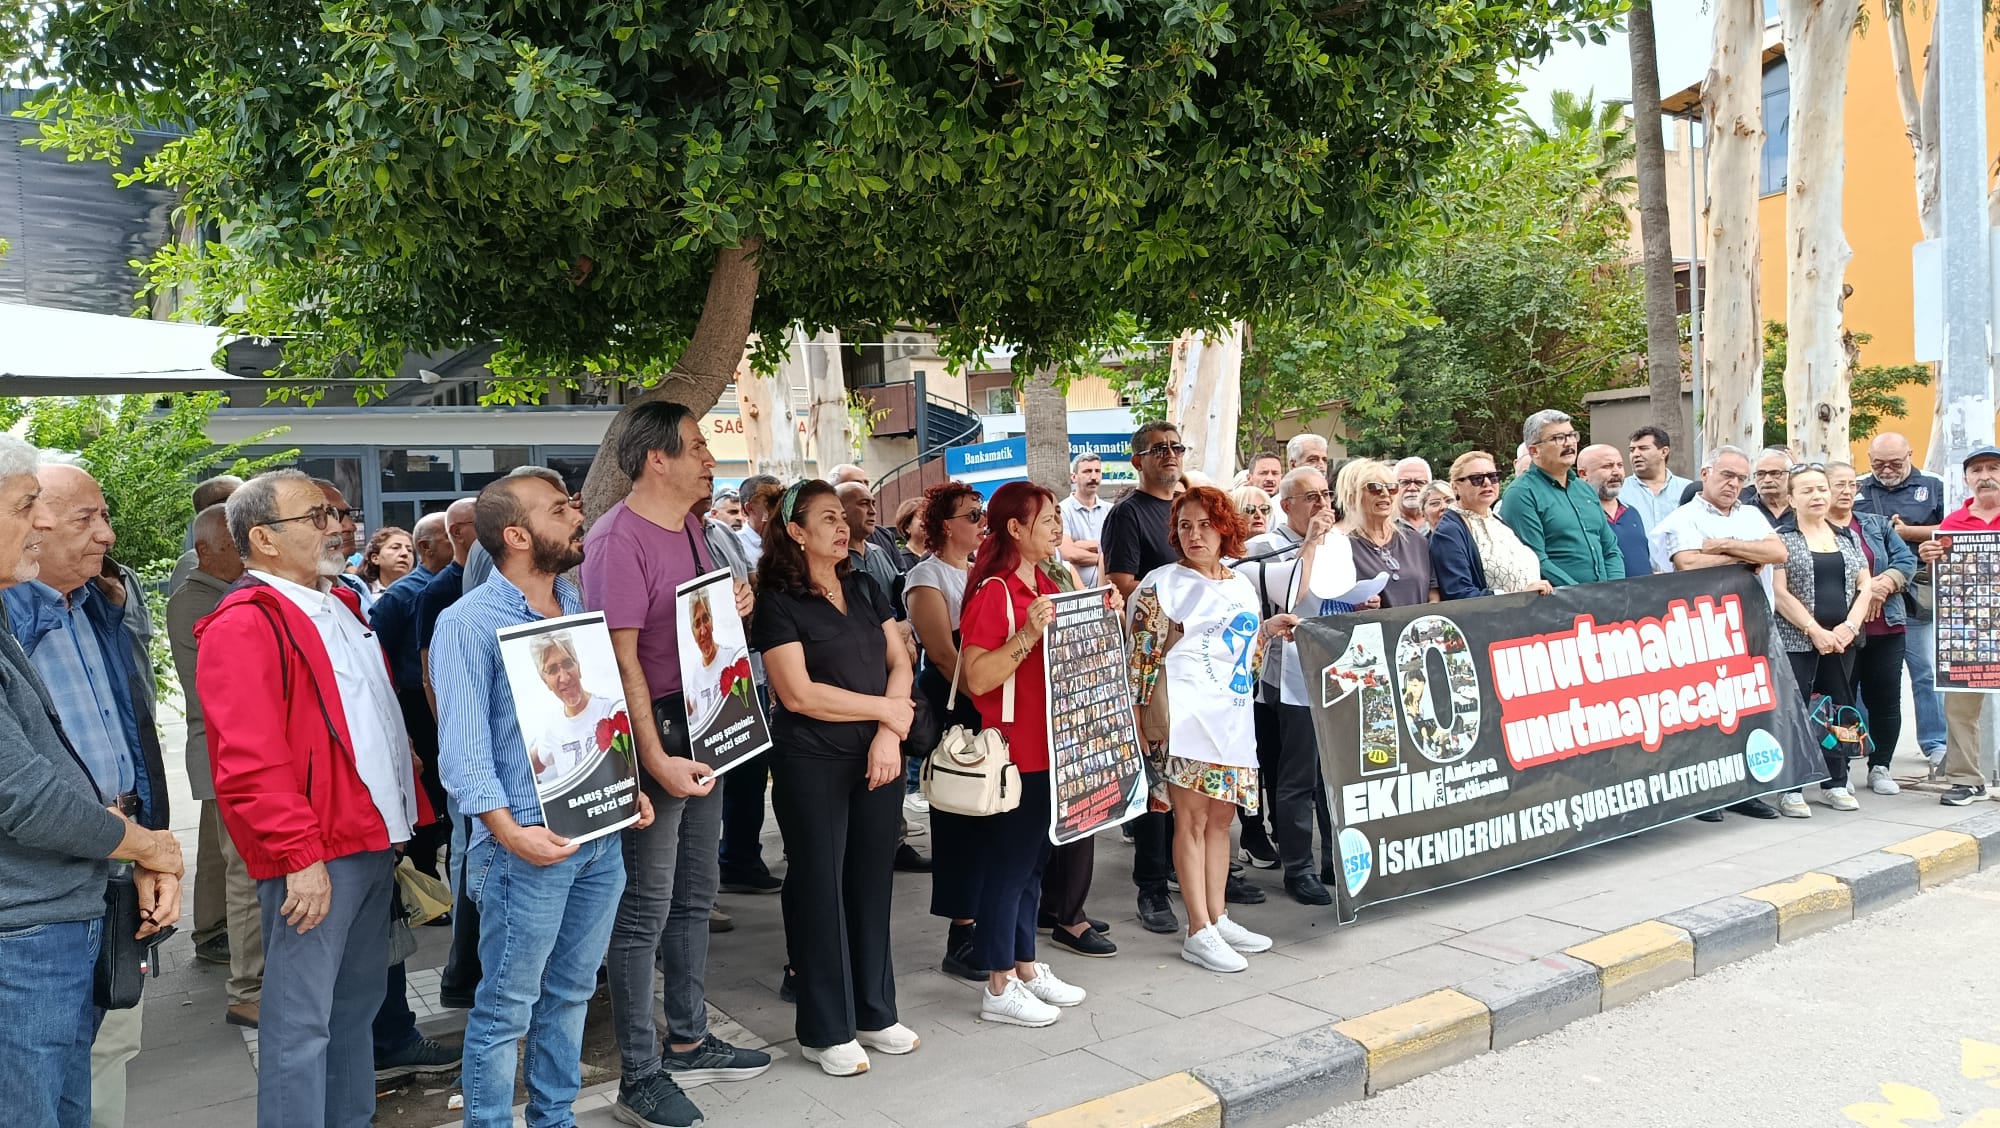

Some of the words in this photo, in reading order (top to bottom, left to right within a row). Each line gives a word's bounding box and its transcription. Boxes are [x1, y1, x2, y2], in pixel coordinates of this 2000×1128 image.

[964, 446, 1013, 465] Bankamatik
[1492, 600, 1746, 701] unutmadık!
[1322, 614, 1481, 777] 10
[1504, 662, 1771, 763] unutmayacağız!
[703, 731, 724, 748] BARIŞ
[714, 738, 735, 756] FEVZİ
[733, 730, 751, 746] SERT
[1444, 757, 1498, 784] Ankara
[1748, 748, 1782, 768] KESK
[567, 789, 603, 809] BARIŞ
[1342, 762, 1446, 826] EKİM
[1436, 773, 1445, 804] 2015
[586, 797, 618, 818] FEVZİ
[1378, 812, 1517, 877] İSKENDERUN
[1520, 798, 1571, 841] KESK
[1571, 777, 1649, 832] ŞUBELER
[1648, 752, 1746, 805] PLATFORMU
[1343, 851, 1371, 875] ESK
